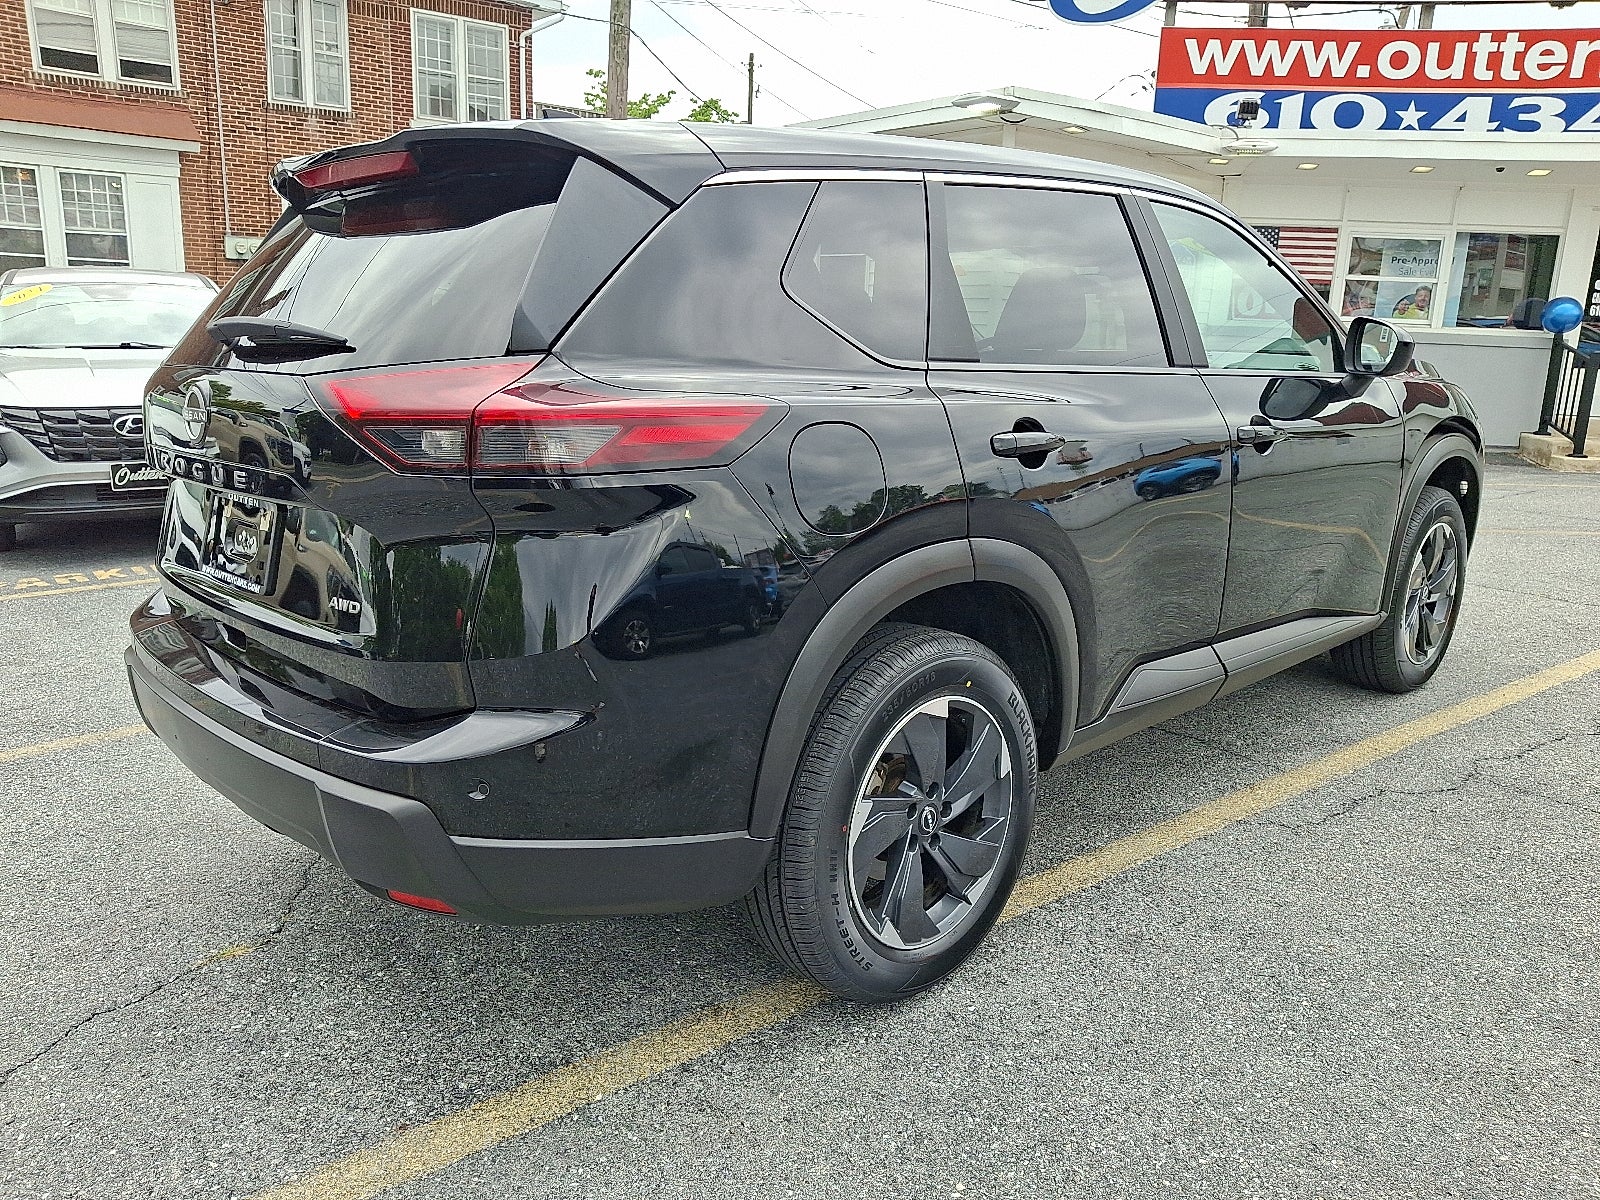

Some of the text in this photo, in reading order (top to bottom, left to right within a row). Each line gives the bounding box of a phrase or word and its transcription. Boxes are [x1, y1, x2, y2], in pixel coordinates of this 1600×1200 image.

[1391, 256, 1455, 267] Pre-Appro
[115, 467, 168, 486] Outten
[160, 452, 247, 489] ROGUE
[228, 492, 259, 508] OUTTEN
[0, 564, 156, 590] ARKI
[327, 596, 361, 614] AWD
[830, 892, 874, 972] STREET-H
